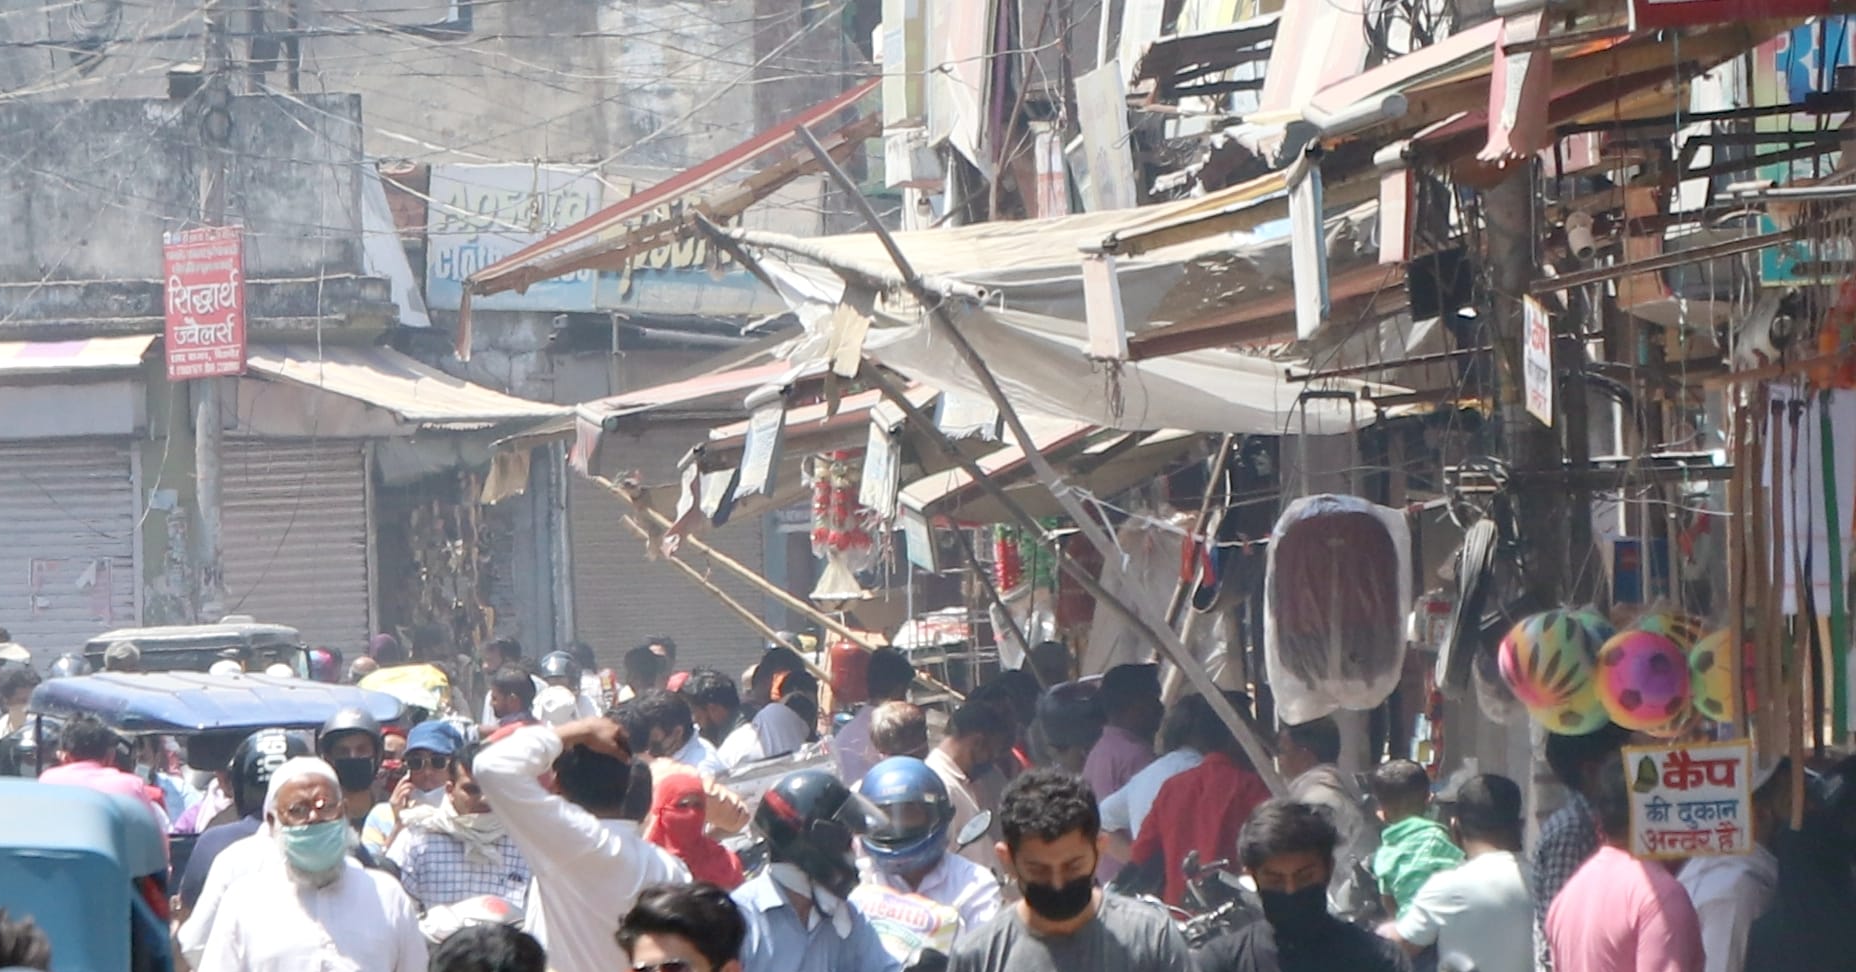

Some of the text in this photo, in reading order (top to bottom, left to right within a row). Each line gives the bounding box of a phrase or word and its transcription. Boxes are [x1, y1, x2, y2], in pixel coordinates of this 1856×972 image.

[168, 270, 238, 314] सिद्धार्थ
[173, 314, 235, 344] ज्वैलर्स
[1663, 750, 1740, 790] कैप
[1644, 796, 1740, 830] की दुकान
